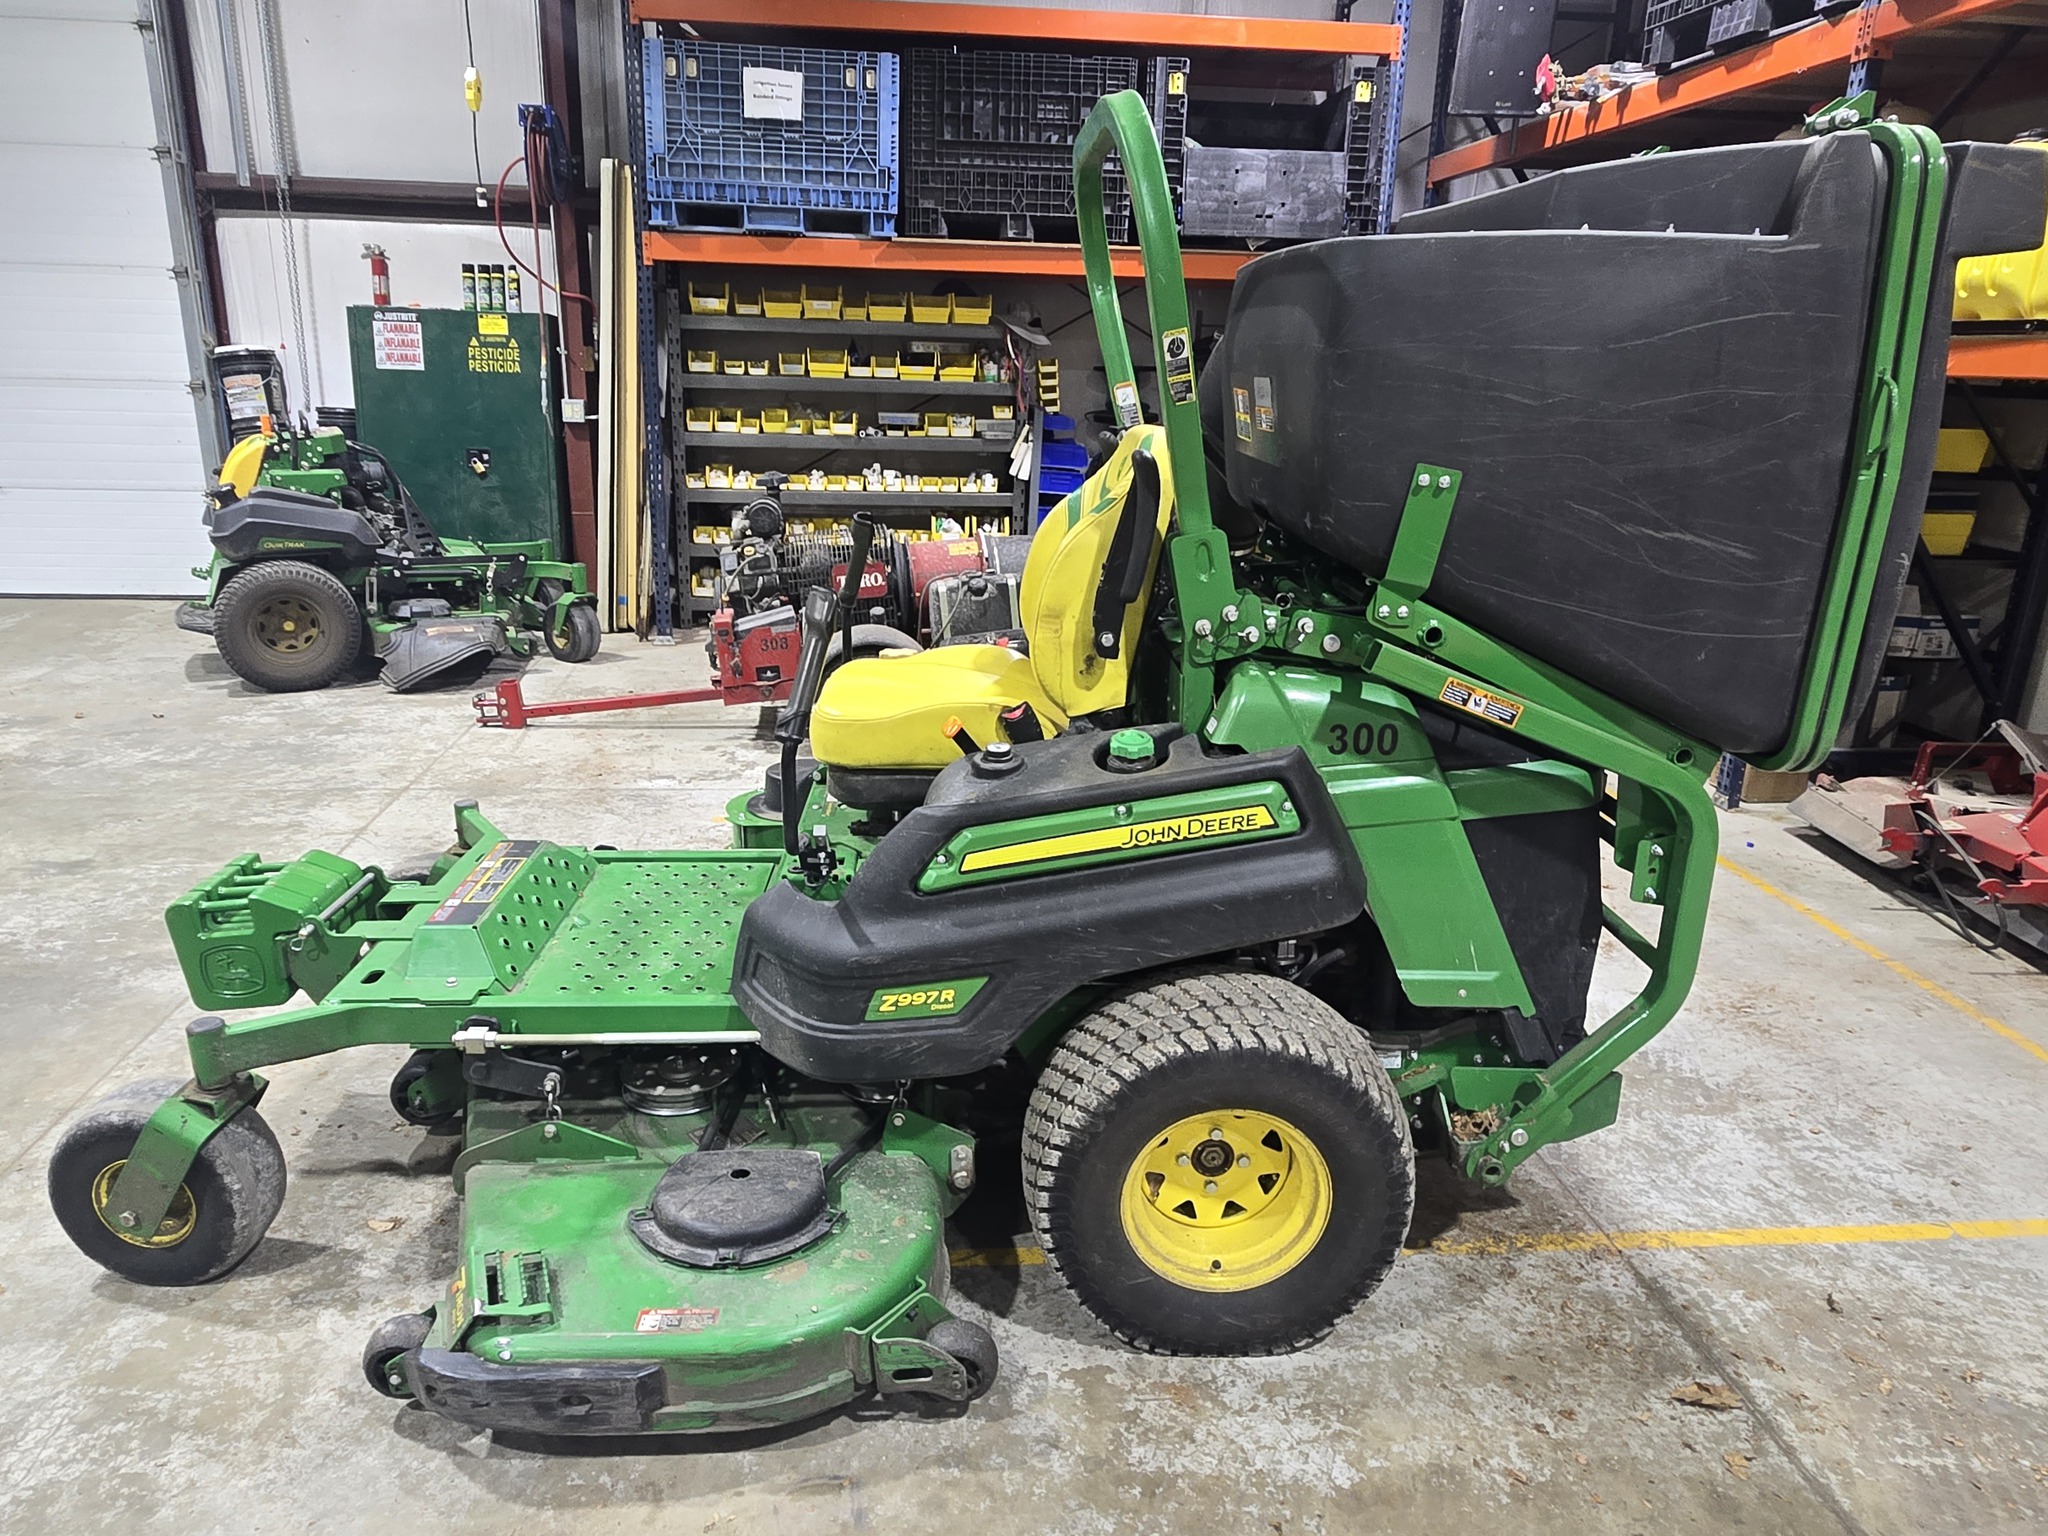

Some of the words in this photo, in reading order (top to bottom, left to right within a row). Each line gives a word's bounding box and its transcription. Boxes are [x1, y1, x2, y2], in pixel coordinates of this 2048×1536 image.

[383, 322, 419, 335] FLAMMABLE
[468, 347, 521, 361] PESTICIDE
[469, 360, 522, 374] PESTICIDA
[1327, 723, 1399, 755] 300
[1121, 824, 1181, 845] JOHN
[1188, 813, 1259, 835] DEERE
[879, 989, 955, 1011] Z997R
